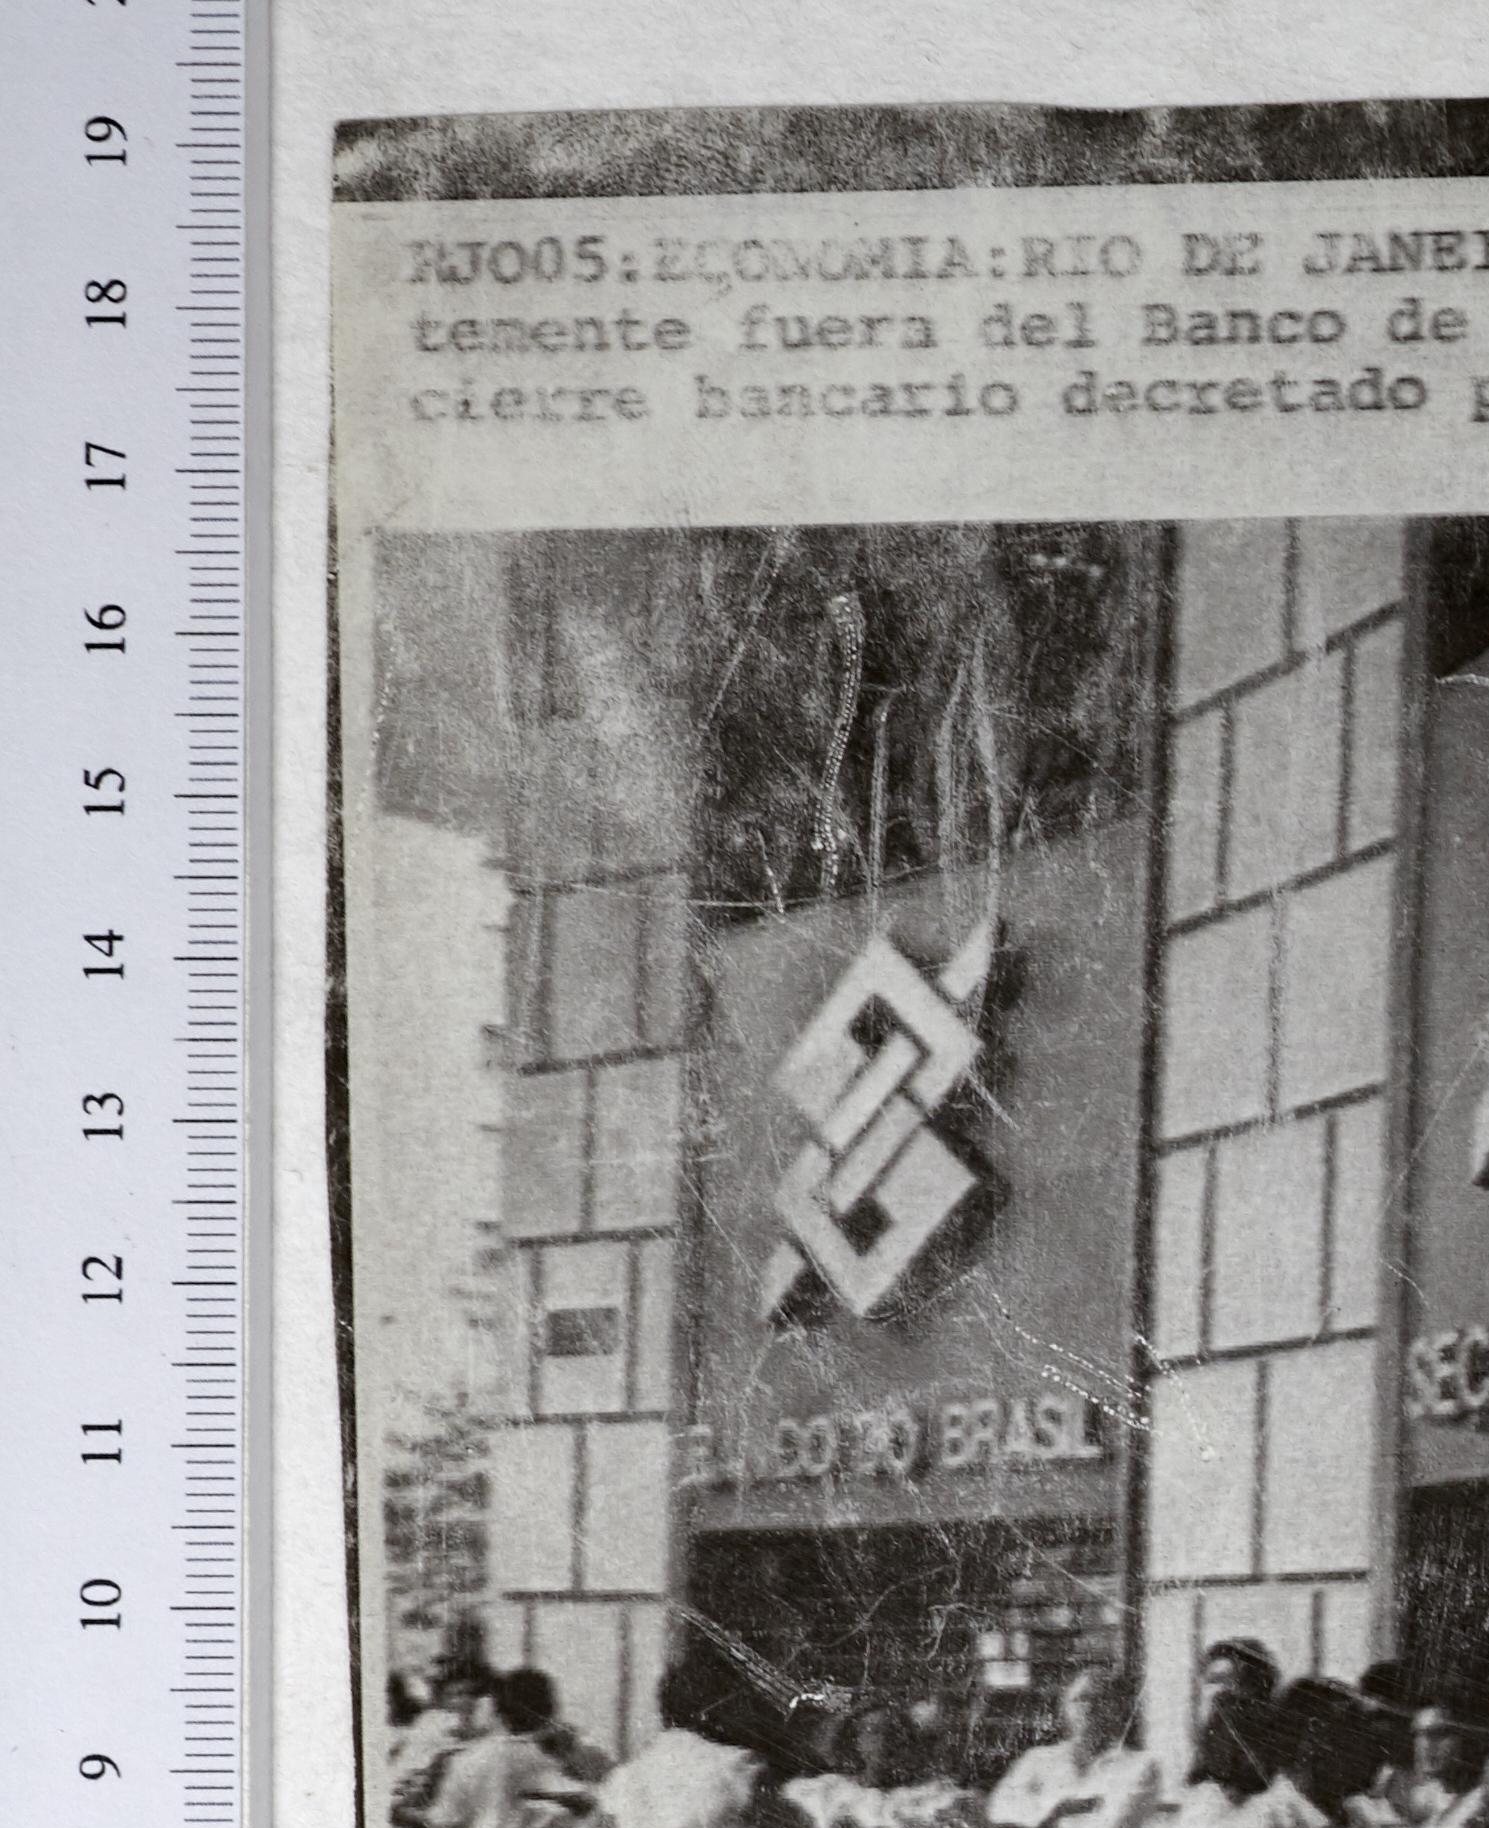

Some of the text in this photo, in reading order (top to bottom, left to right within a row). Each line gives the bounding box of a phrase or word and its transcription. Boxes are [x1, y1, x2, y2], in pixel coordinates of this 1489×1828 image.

[84, 115, 128, 165] 19
[84, 278, 128, 328] 18
[84, 441, 127, 489] 17
[83, 603, 127, 654] 16
[82, 767, 126, 815] 15
[82, 928, 125, 978] 14
[81, 1092, 125, 1139] 13
[81, 1255, 124, 1303] 12
[80, 1420, 123, 1464] 11
[79, 1578, 122, 1629] 10
[78, 1753, 121, 1781] 9
